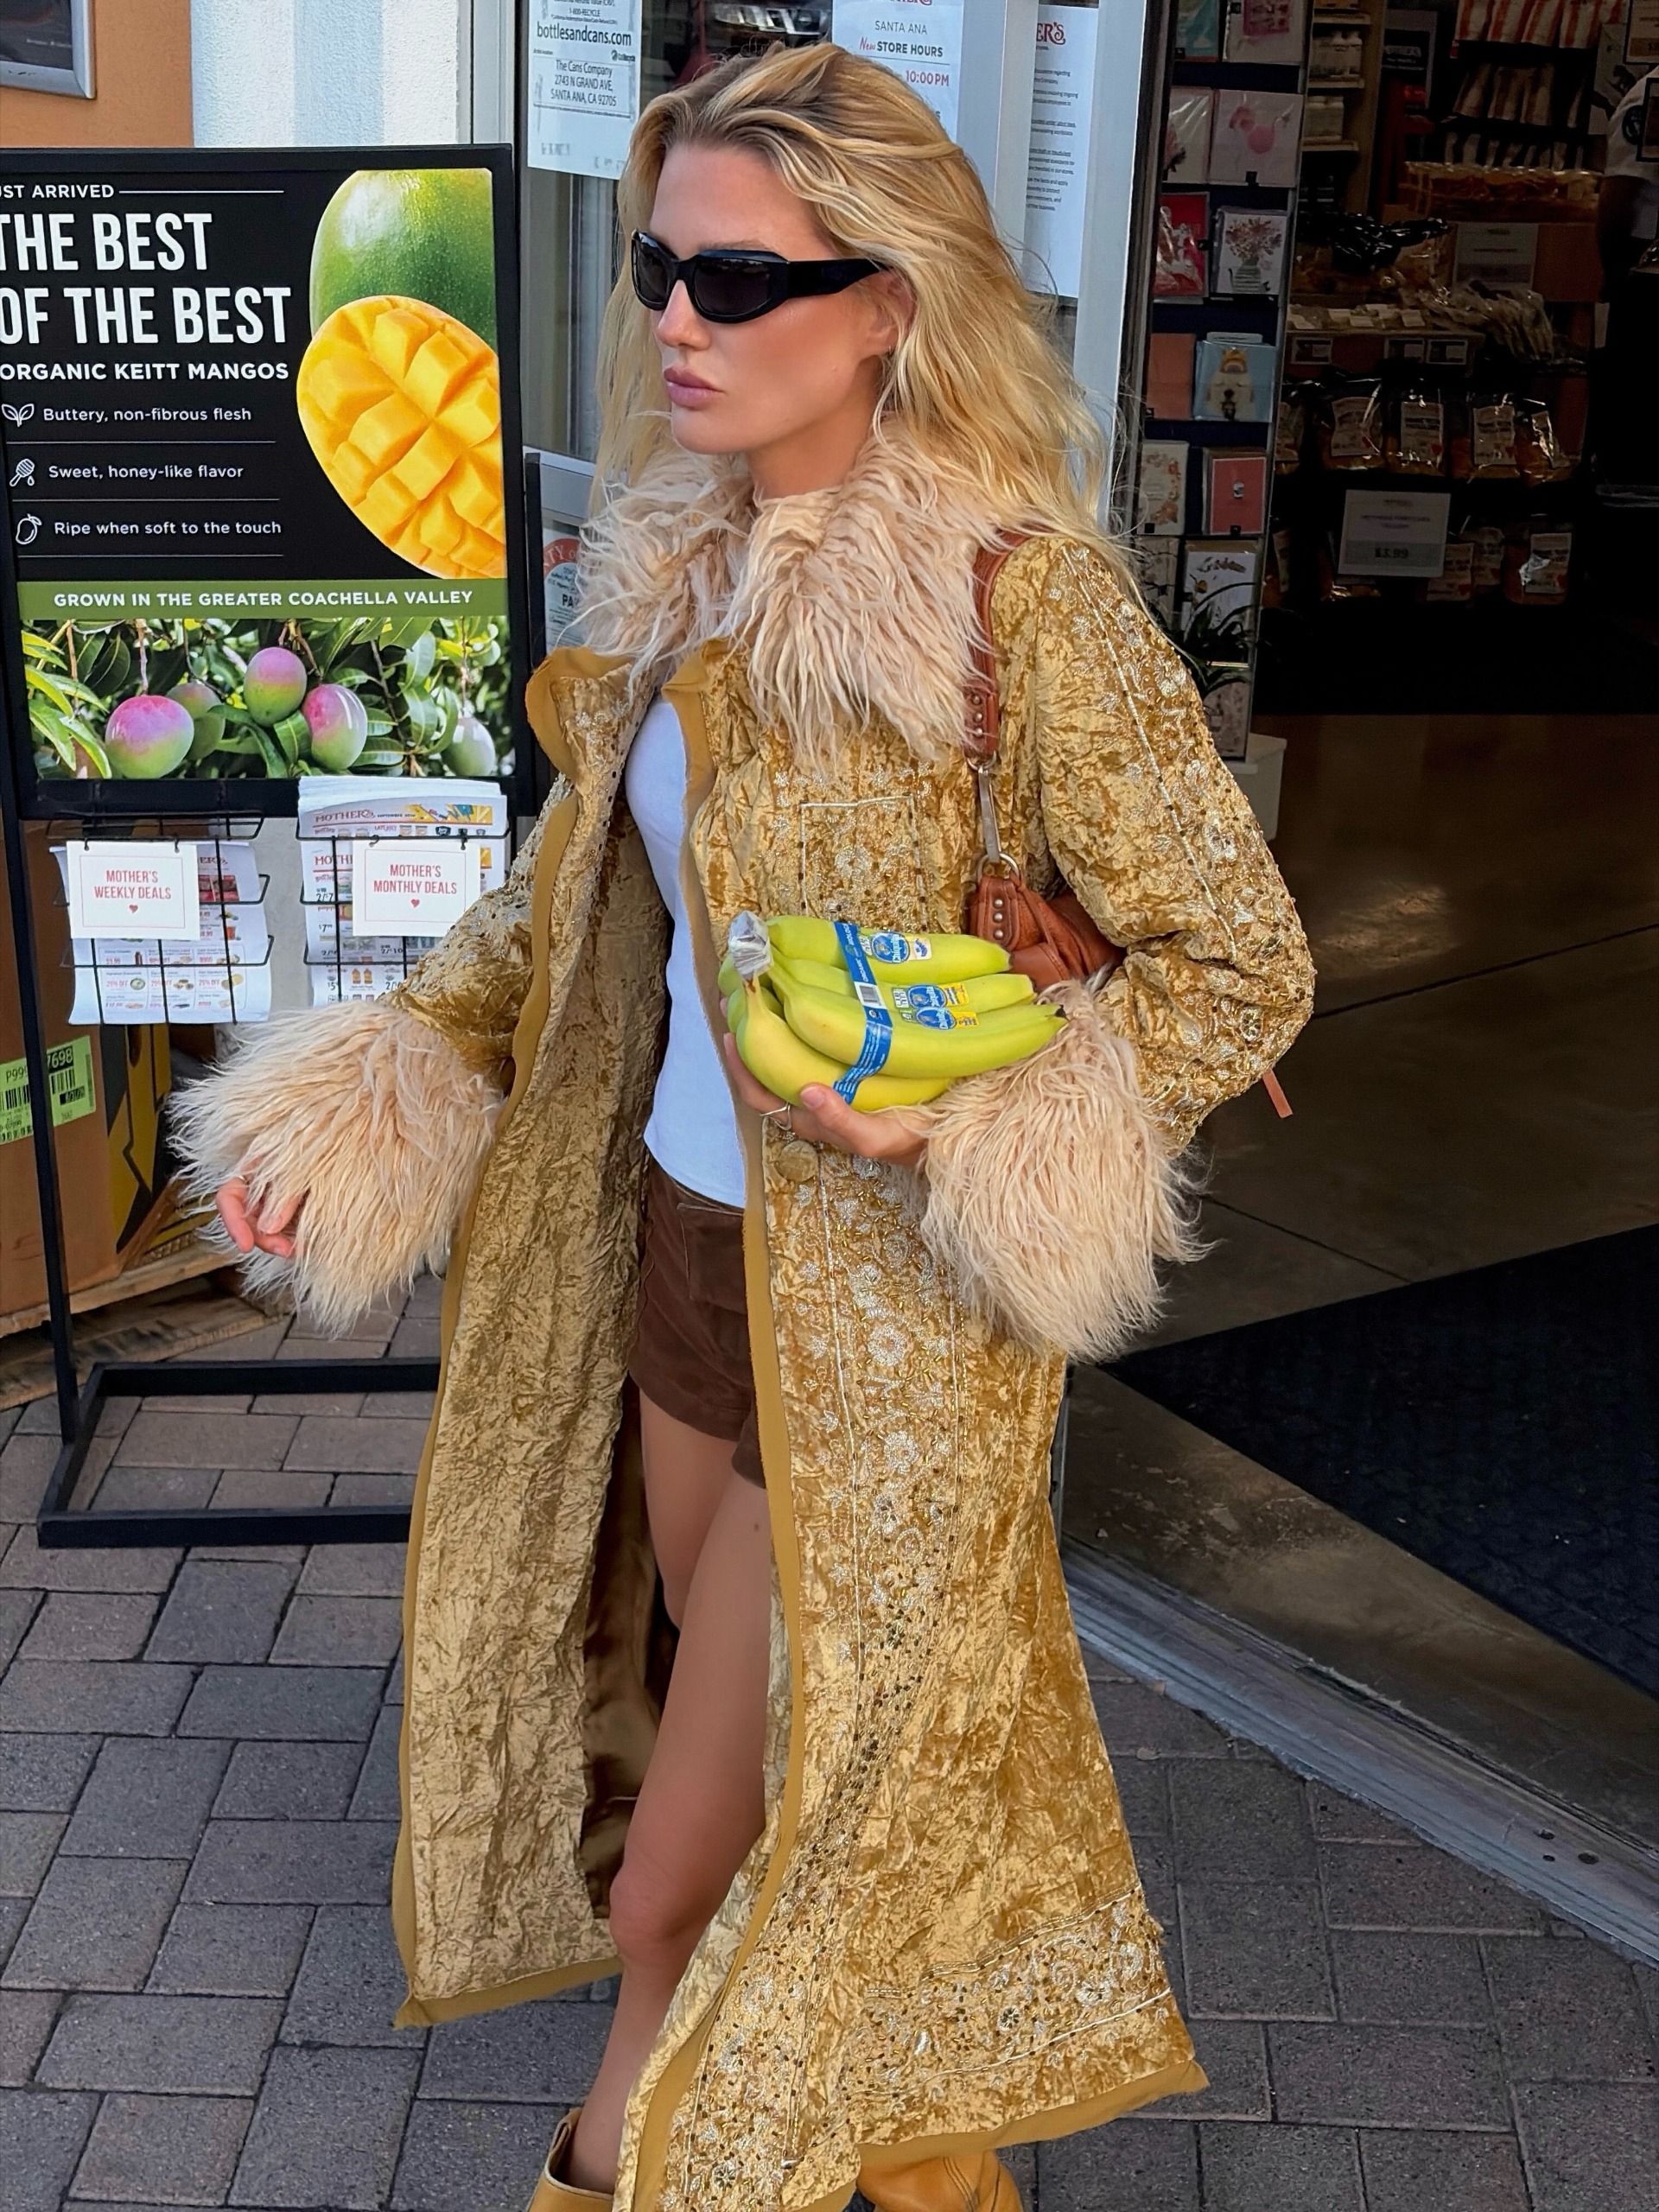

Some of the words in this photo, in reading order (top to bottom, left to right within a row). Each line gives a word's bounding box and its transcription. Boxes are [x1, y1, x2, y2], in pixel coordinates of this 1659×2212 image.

[537, 21, 632, 47] bottlesandcans.com
[874, 20, 906, 33] SANTA
[907, 23, 928, 35] ANA
[859, 35, 875, 51] New
[877, 41, 908, 54] STORE
[910, 43, 944, 58] HOURS
[556, 59, 567, 72] The
[568, 60, 583, 74] Cans
[583, 62, 613, 78] Company
[554, 74, 569, 86] 2743
[576, 77, 599, 89] GRAND
[550, 88, 571, 100] SANTA
[588, 92, 597, 104] CA
[598, 95, 617, 107] 92705
[0, 185, 25, 199] ST
[32, 184, 115, 199] ARRIVED
[0, 213, 79, 271] THE
[92, 213, 213, 271] BEST
[0, 287, 49, 345] OF
[64, 287, 159, 344] THE
[173, 286, 291, 344] BEST
[0, 363, 107, 380] ORGANIC
[114, 363, 180, 380] KEITT
[188, 362, 289, 380] MANGOS
[43, 408, 108, 423] Buttery,
[113, 407, 208, 421] non-fibrous
[213, 407, 251, 421] flesh
[48, 465, 104, 480] Sweet,
[108, 465, 193, 480] honey-like
[198, 464, 244, 478] flavor
[54, 522, 91, 537] Ripe
[96, 521, 139, 535] when
[144, 521, 176, 535] soft
[181, 522, 199, 534] to
[203, 521, 230, 534] the
[235, 521, 282, 534] touch
[54, 593, 125, 607] GROWN
[131, 593, 150, 607] IN
[156, 593, 193, 607] THE
[198, 593, 282, 607] GREATER
[288, 591, 398, 606] COACHELLA
[404, 590, 473, 604] VALLEY
[315, 855, 353, 866] MOTH
[105, 869, 159, 884] MOTHER'S
[390, 864, 442, 879] MOTHER'S
[93, 885, 135, 899] WEEKLY
[137, 886, 172, 900] DEALS
[373, 880, 422, 894] MONTHLY
[424, 880, 458, 895] DEALS
[891, 933, 902, 963] Chiquita
[5, 1065, 28, 1084] P99
